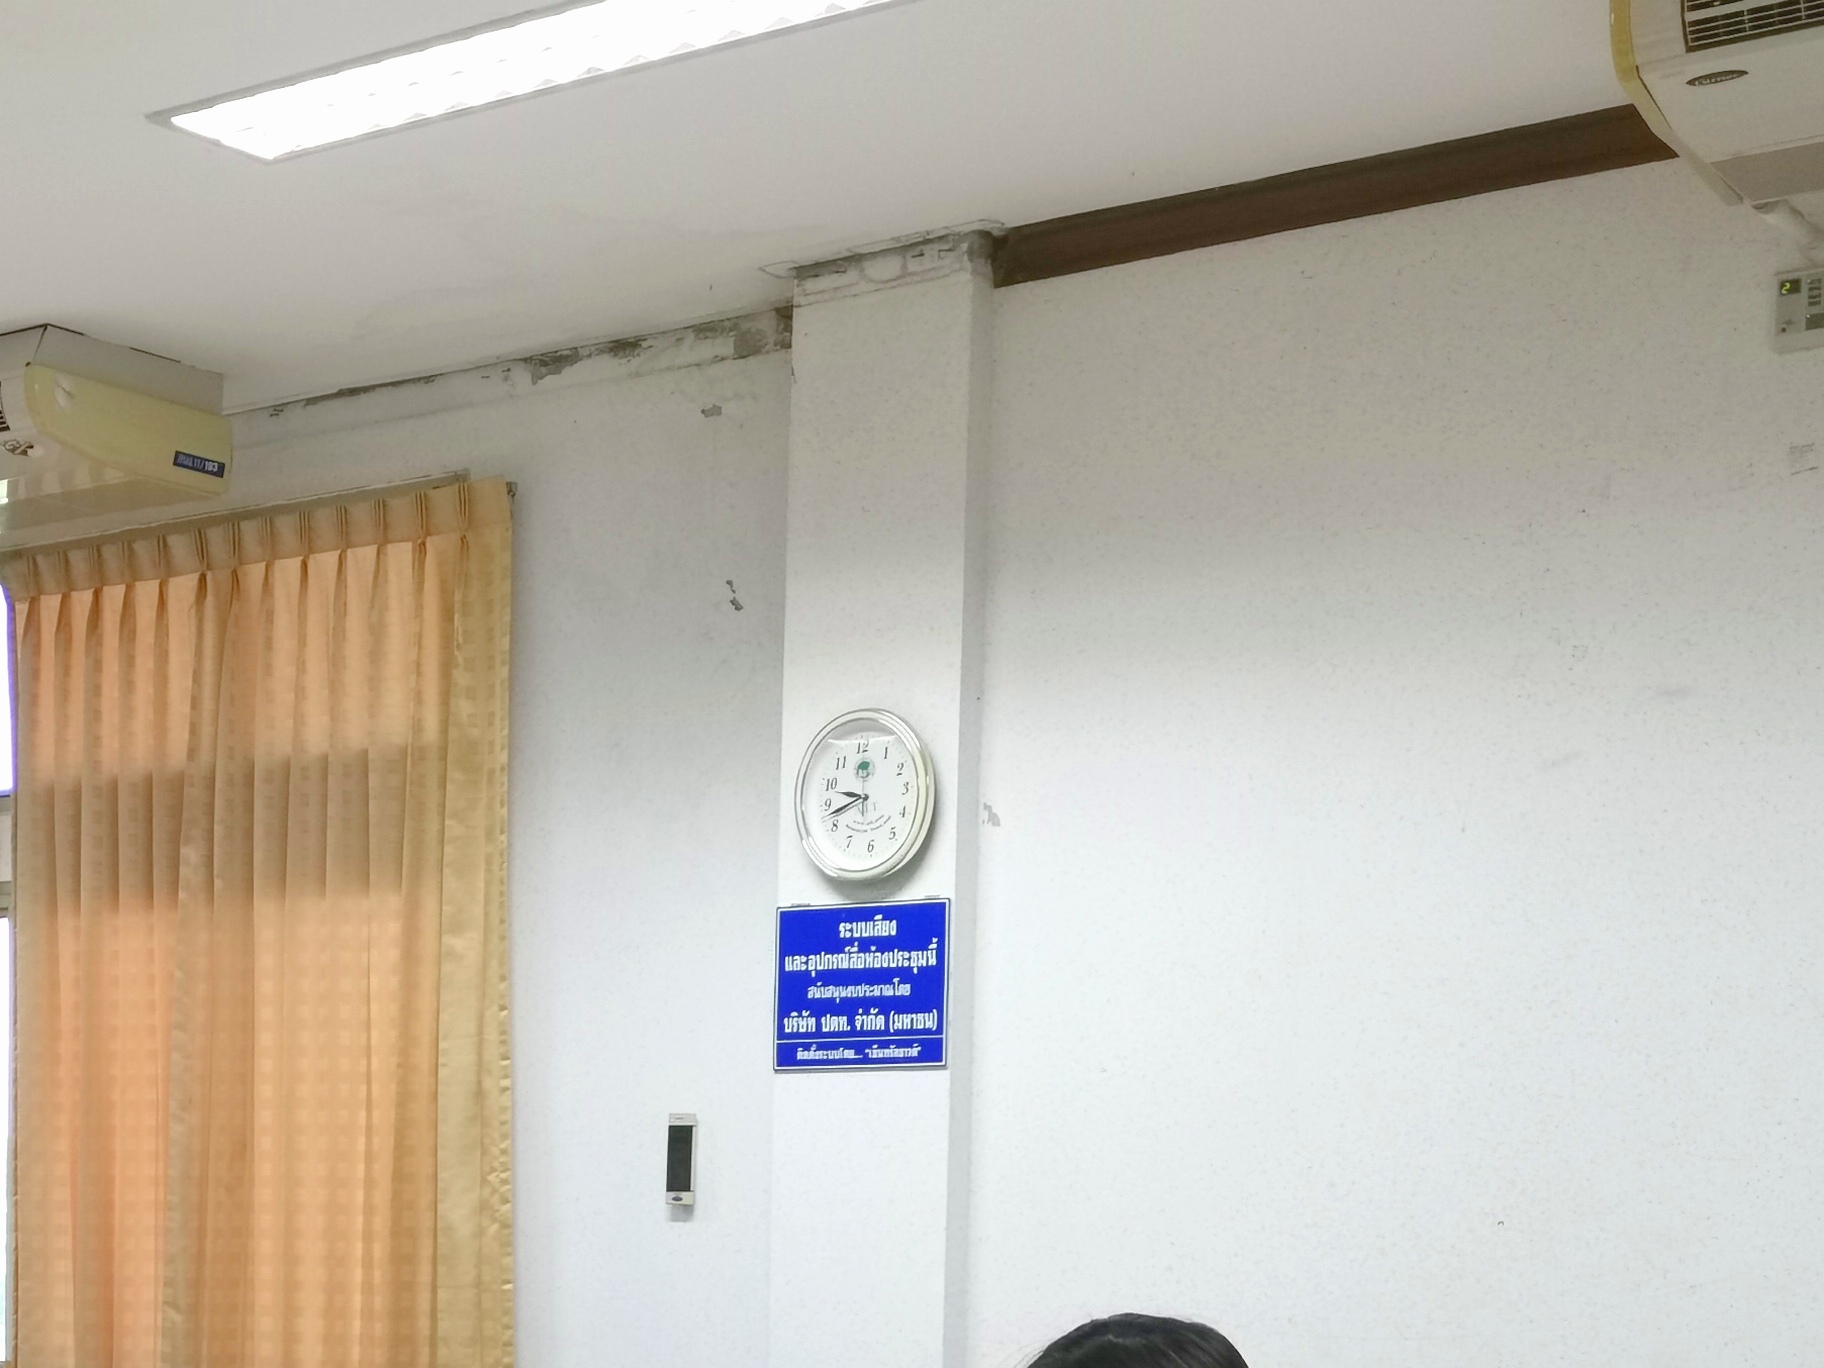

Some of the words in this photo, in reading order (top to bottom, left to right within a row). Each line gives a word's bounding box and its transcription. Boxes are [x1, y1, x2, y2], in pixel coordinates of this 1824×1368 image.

[856, 739, 869, 754] 12
[883, 746, 889, 760] 1
[835, 755, 847, 770] 11
[896, 762, 905, 776] 2
[825, 777, 837, 791] 10
[902, 781, 909, 795] 3
[824, 798, 832, 812] 9
[899, 805, 906, 818] 4
[831, 819, 839, 832] 8
[889, 827, 896, 840] 5
[846, 835, 853, 849] 7
[867, 839, 875, 853] 6
[839, 914, 897, 938] ระบบเสียง
[784, 937, 938, 977] และอุปกรณ์สื่อห้องประชุมนี้
[783, 1010, 816, 1033] บริษัท
[821, 1013, 851, 1033] ปตท.
[855, 1007, 885, 1032] จำกัด
[889, 1008, 938, 1033] (มหาชน)
